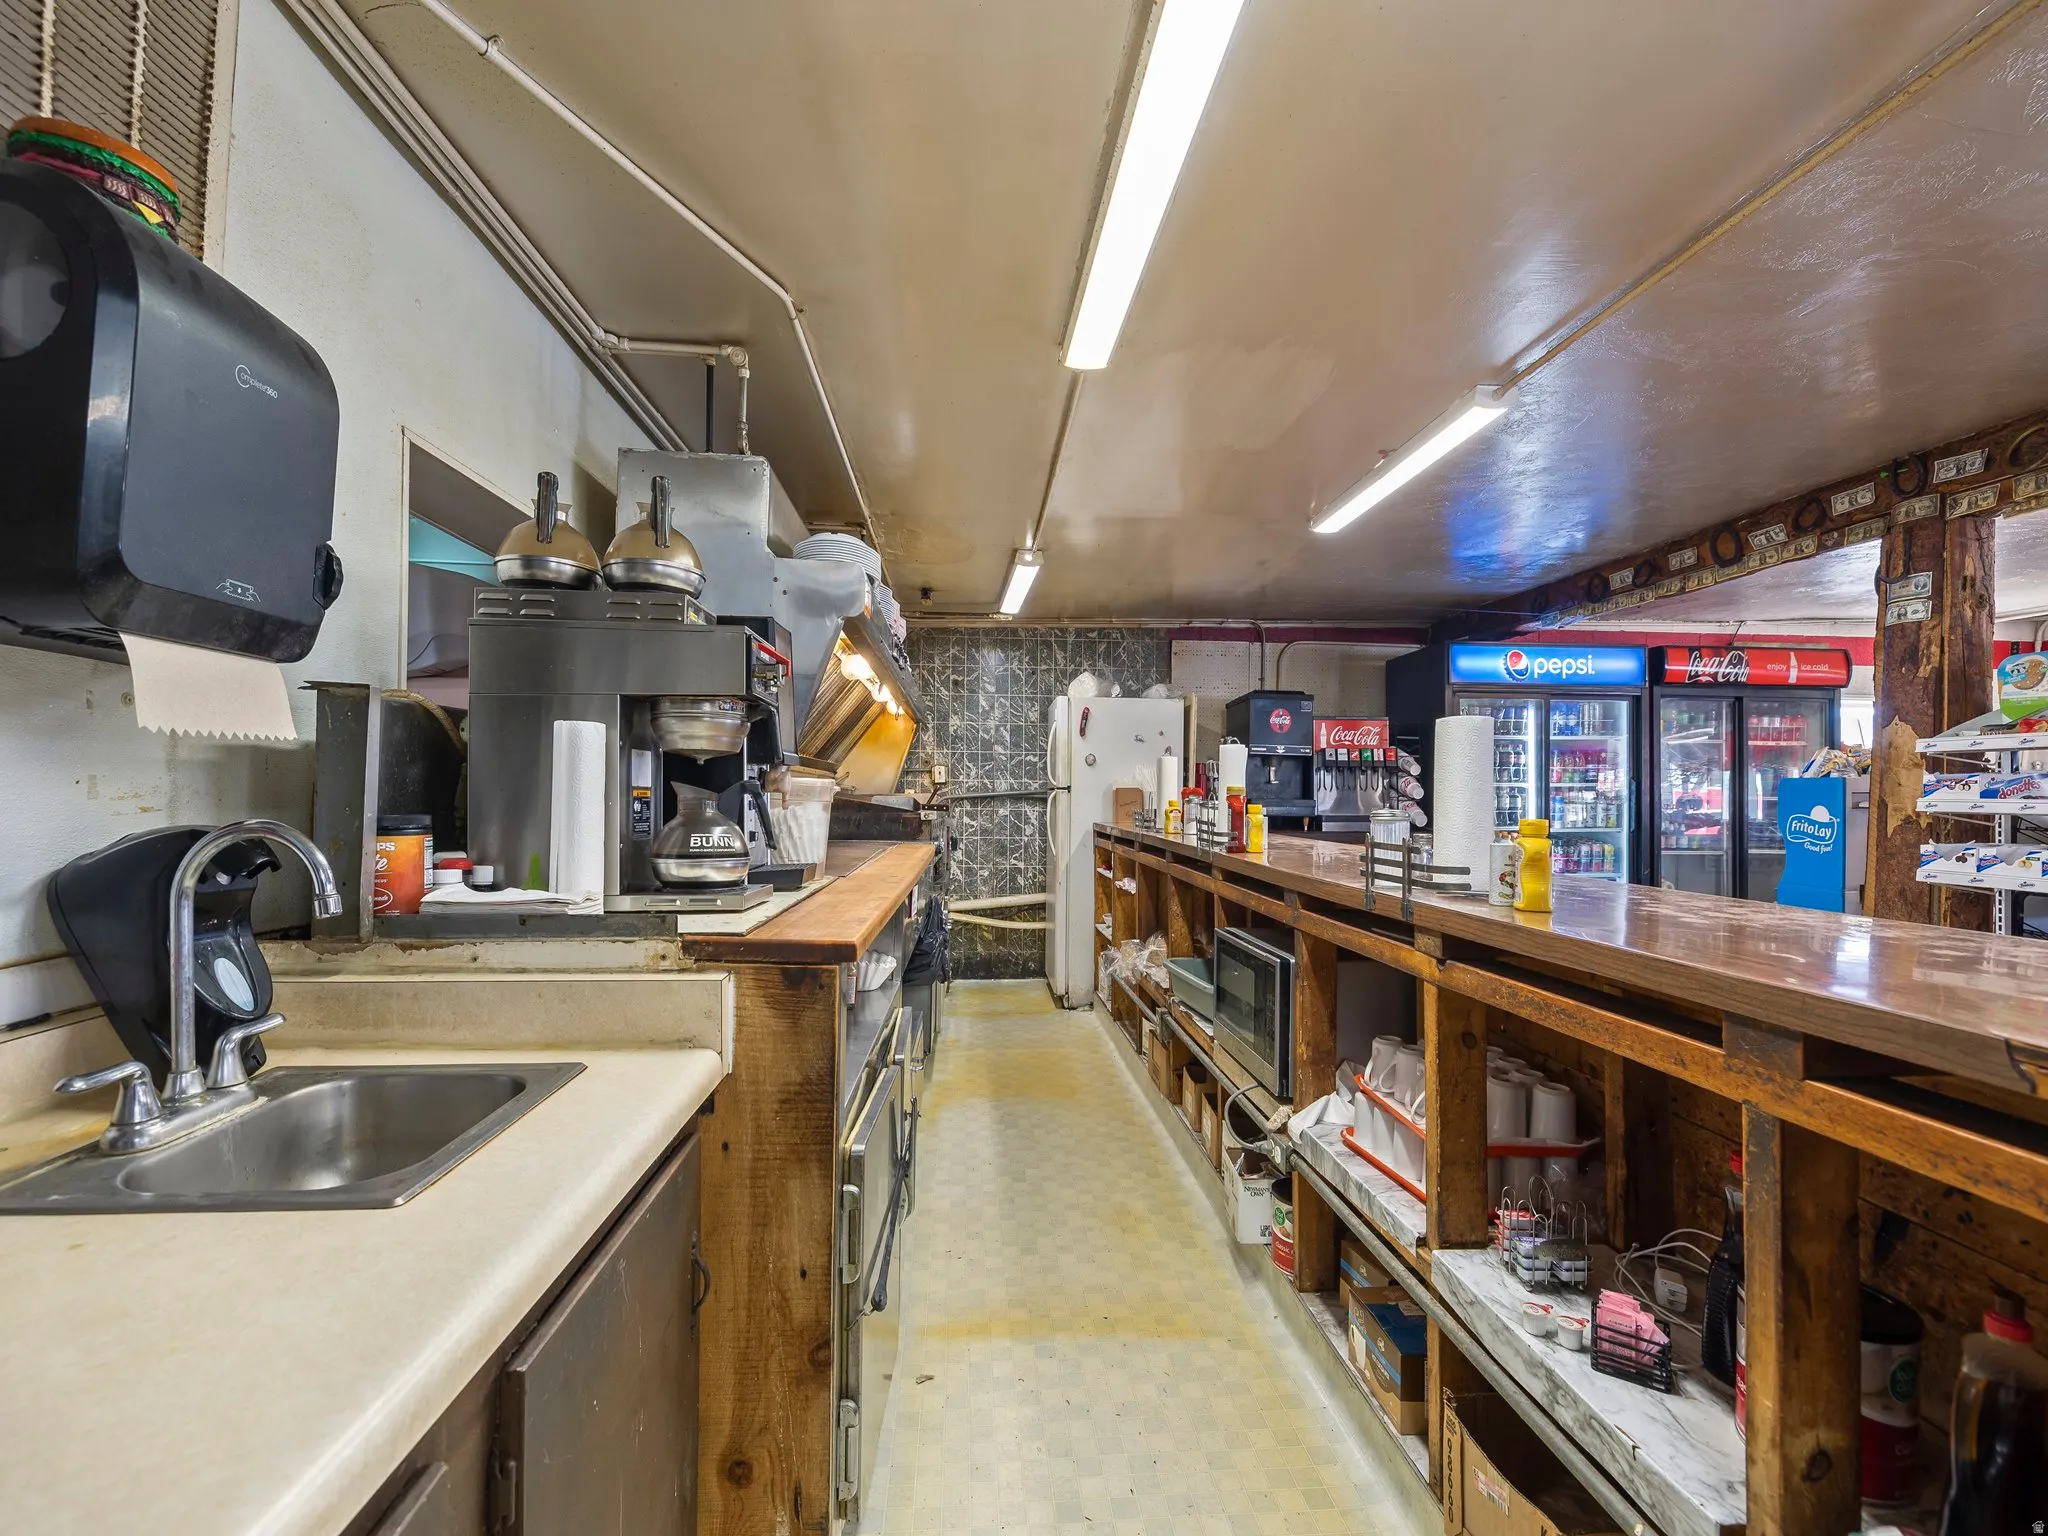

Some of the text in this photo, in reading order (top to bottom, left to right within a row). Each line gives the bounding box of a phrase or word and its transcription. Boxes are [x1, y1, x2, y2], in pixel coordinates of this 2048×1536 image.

[1766, 662, 1787, 672] enjoy
[1330, 725, 1382, 746] Coca-Cola
[690, 836, 735, 847] BUNN
[1804, 842, 1820, 852] Good
